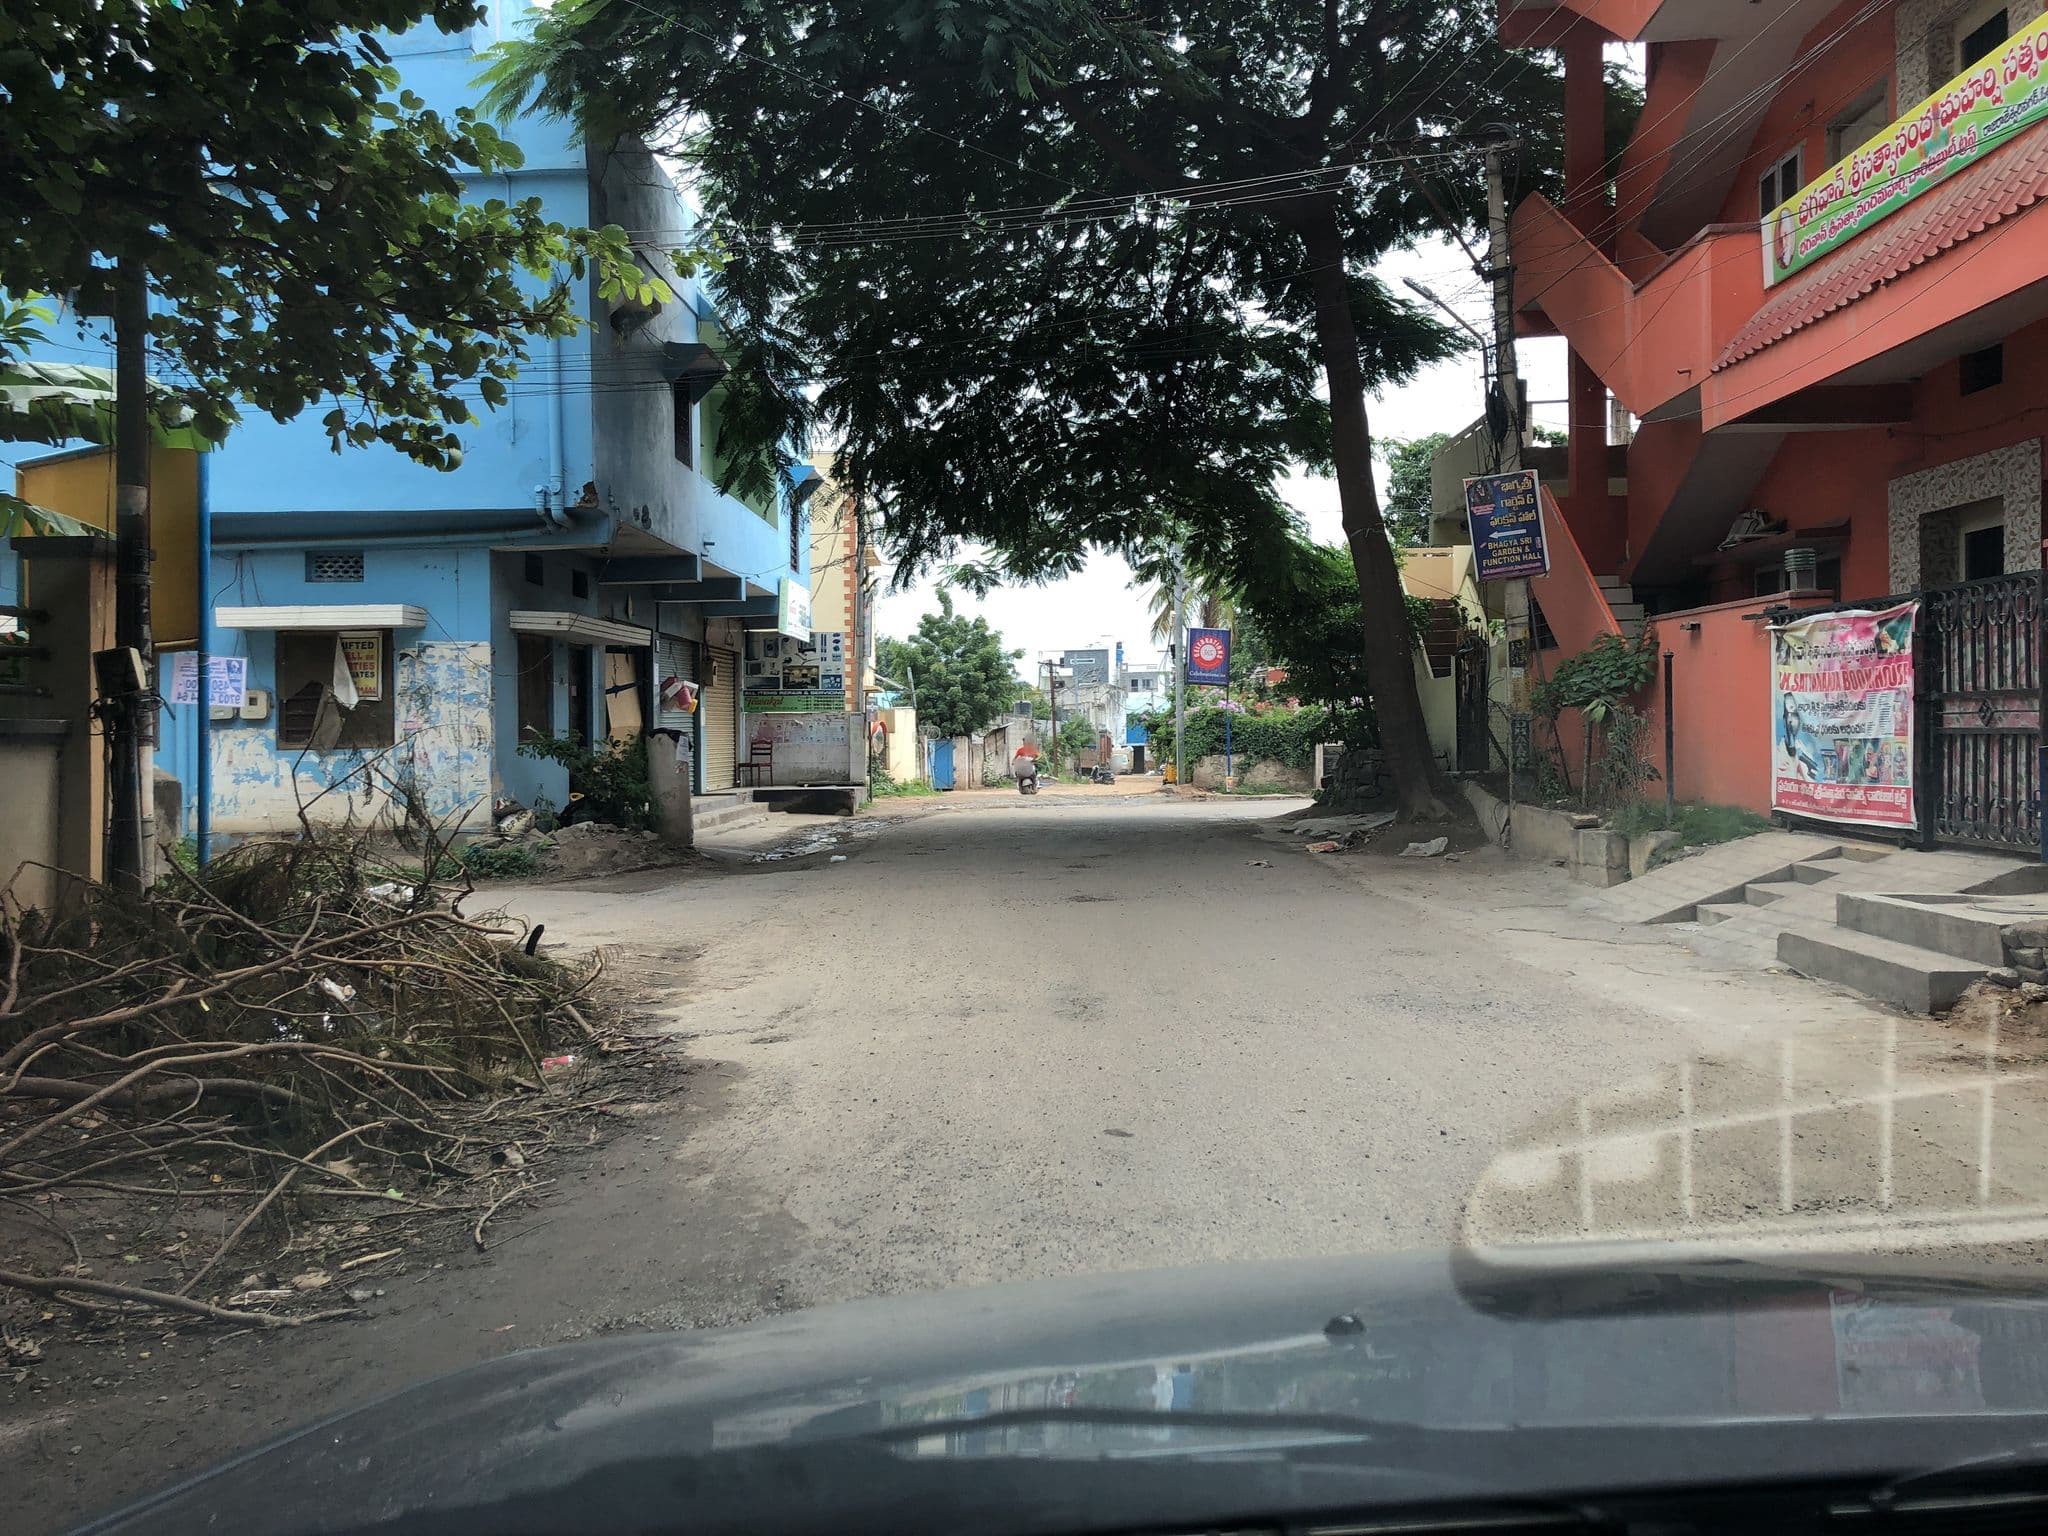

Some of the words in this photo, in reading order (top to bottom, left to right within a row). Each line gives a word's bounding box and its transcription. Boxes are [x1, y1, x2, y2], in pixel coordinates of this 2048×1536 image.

[1488, 539, 1518, 550] BHAGYA
[1520, 537, 1532, 546] SRI
[1492, 547, 1522, 557] GARDEN
[1483, 556, 1521, 567] FUNCTION
[1522, 552, 1542, 562] HALL
